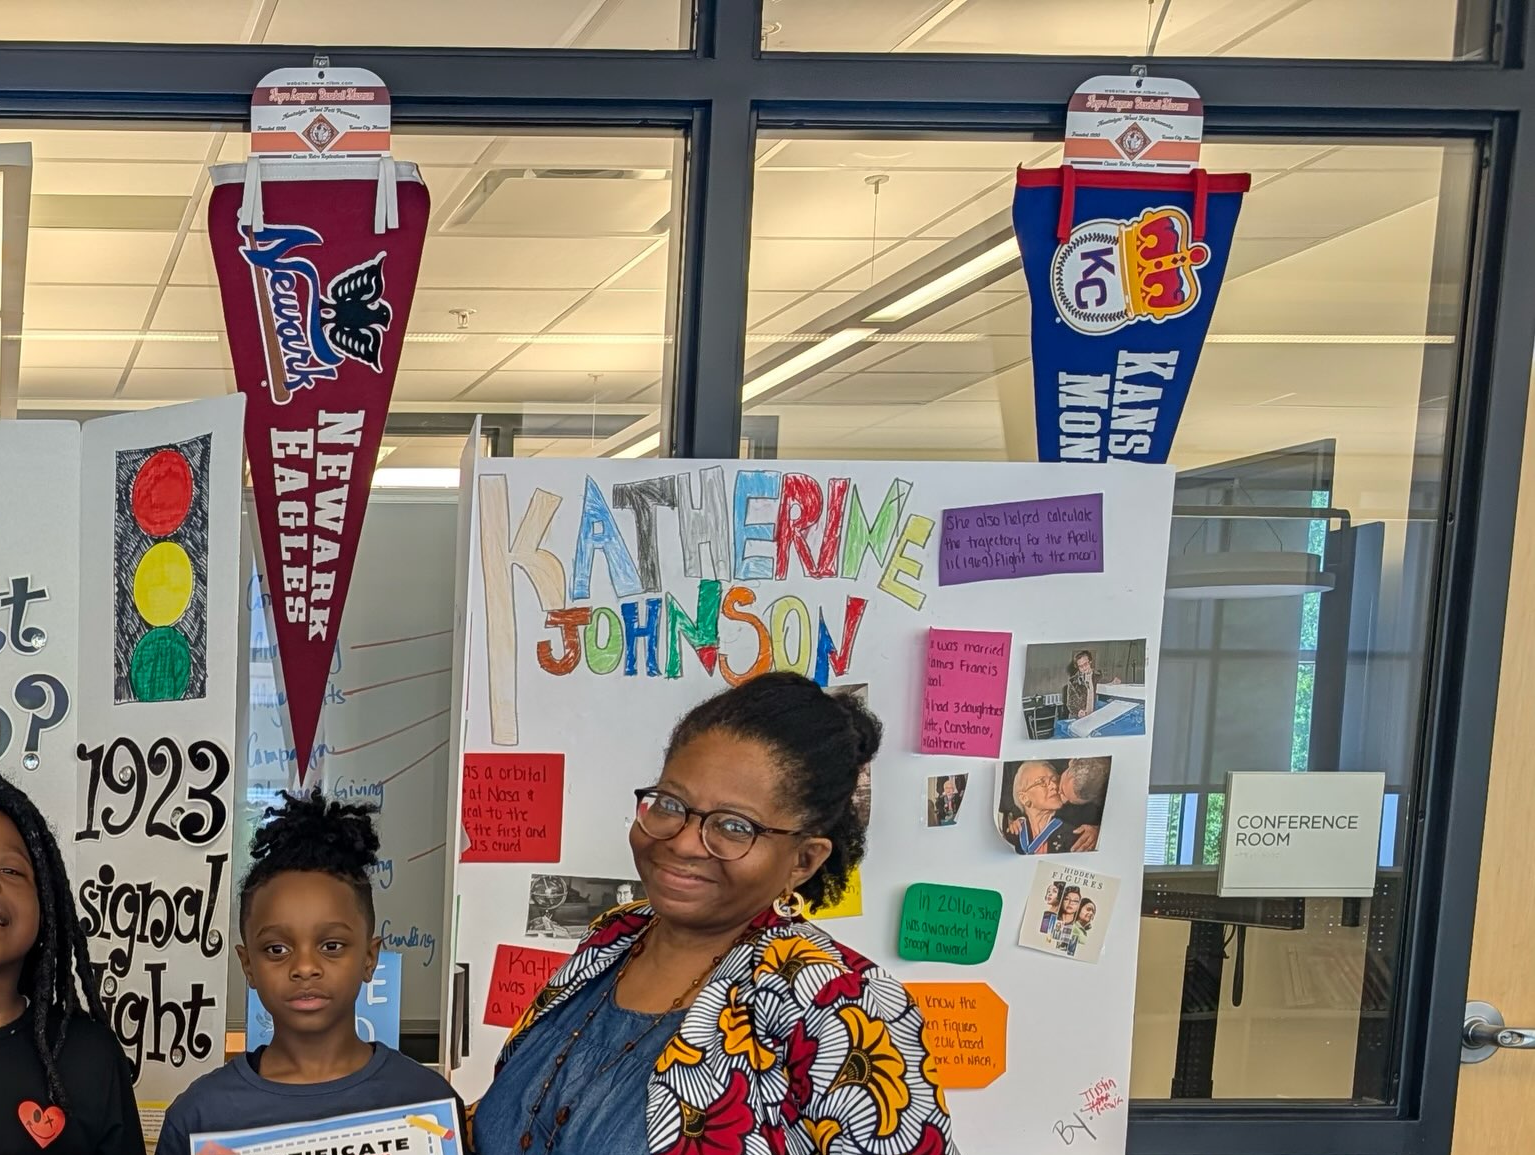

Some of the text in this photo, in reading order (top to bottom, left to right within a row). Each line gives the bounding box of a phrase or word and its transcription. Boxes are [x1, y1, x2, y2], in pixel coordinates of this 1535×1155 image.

[1074, 246, 1115, 310] KC
[1107, 350, 1180, 464] KANS
[270, 427, 314, 624] EAGLES
[308, 410, 365, 642] NEWARK
[946, 515, 970, 530] She
[976, 512, 1000, 528] also
[478, 465, 936, 746] KATHERINE
[536, 579, 869, 687] JOHNSON
[937, 641, 1005, 657] was married
[960, 659, 998, 677] Francis
[75, 738, 230, 845] 1923
[1236, 814, 1359, 830] CONFERENCE
[1051, 870, 1105, 891] FIGURES
[1235, 832, 1291, 847] ROOM
[79, 853, 229, 977] signal
